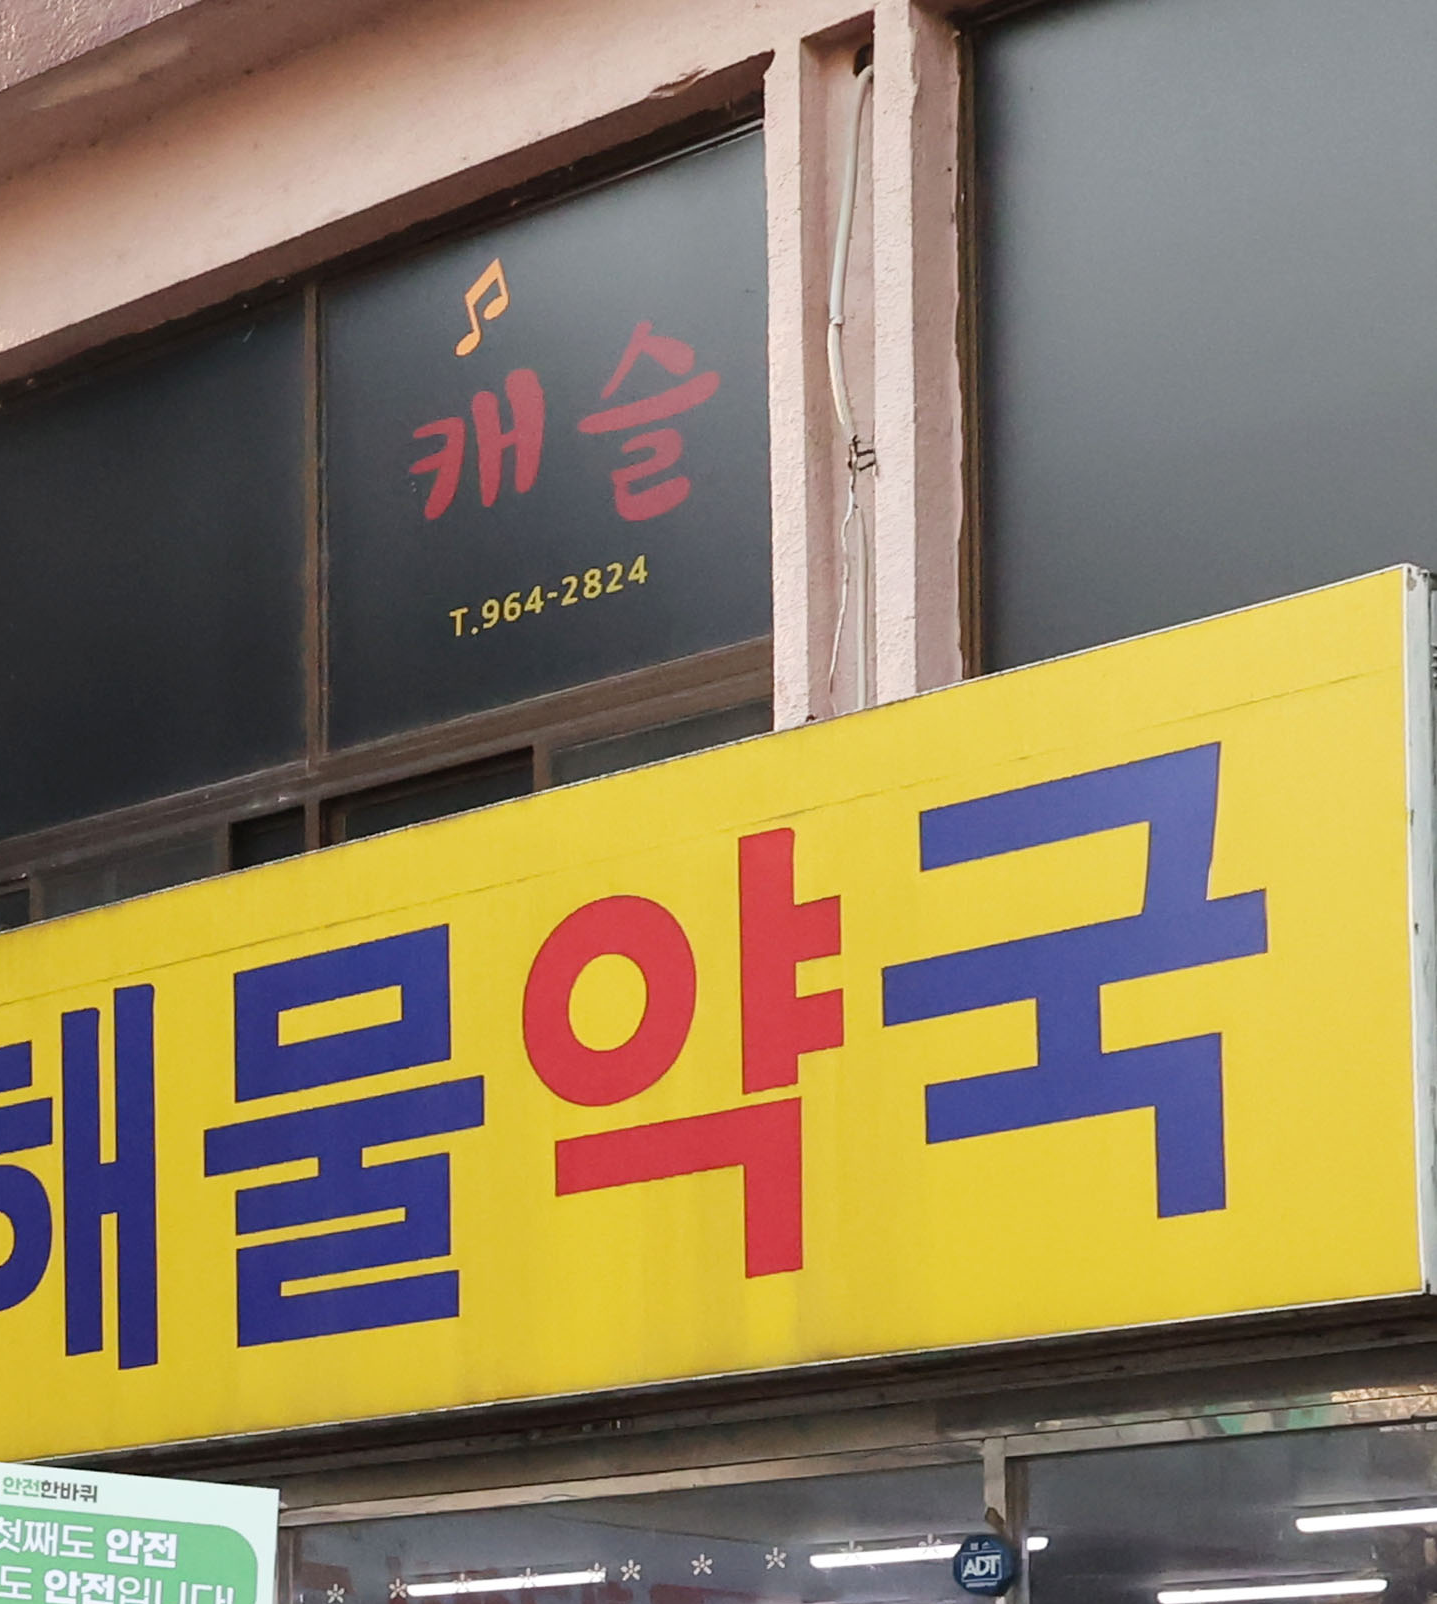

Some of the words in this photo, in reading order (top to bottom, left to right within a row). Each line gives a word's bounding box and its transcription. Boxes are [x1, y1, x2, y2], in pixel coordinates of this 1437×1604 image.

[408, 320, 721, 522] 캐슬
[449, 554, 650, 638] T.964-2824
[2, 1475, 99, 1504] 안전한바퀴
[105, 1529, 179, 1569] 안전
[961, 1554, 1002, 1578] ADT
